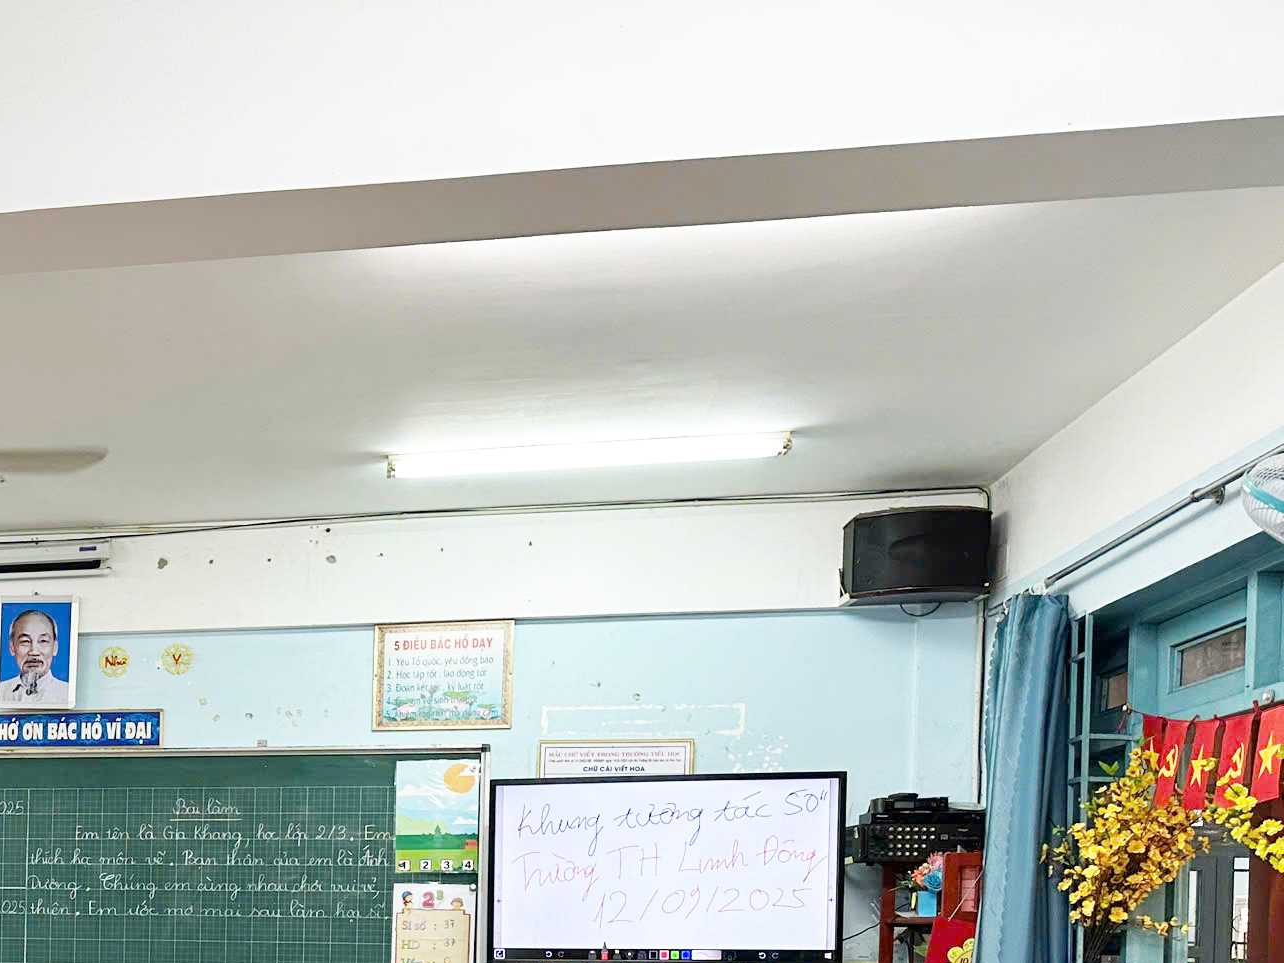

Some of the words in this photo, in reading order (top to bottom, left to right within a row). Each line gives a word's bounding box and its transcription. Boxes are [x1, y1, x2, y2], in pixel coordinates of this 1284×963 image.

[394, 641, 400, 650] 5
[403, 636, 427, 650] ĐIỀU
[430, 636, 451, 649] BÁC
[454, 634, 469, 649] HỒ
[472, 638, 493, 652] DẠY
[22, 720, 43, 741] ƠN
[47, 717, 77, 740] BÁC
[81, 714, 103, 740] HỒ
[107, 718, 122, 740] VĨ
[125, 720, 152, 745] ĐẠI
[614, 764, 628, 772] VIẾT
[75, 825, 99, 840] Em
[107, 827, 130, 840] tên
[136, 824, 156, 840] là
[163, 825, 187, 840] Gia
[364, 824, 394, 840] Em
[517, 803, 604, 857] Khung
[713, 791, 772, 821] tác
[99, 852, 136, 865] môn
[181, 850, 217, 869] Bạn
[227, 849, 265, 866] thân
[422, 861, 429, 869] 2
[444, 861, 451, 869] 3
[465, 861, 471, 869] 4
[607, 842, 661, 879] TH
[88, 901, 116, 916] Em
[422, 891, 435, 908] 2
[594, 888, 813, 929] 12/09/2025
